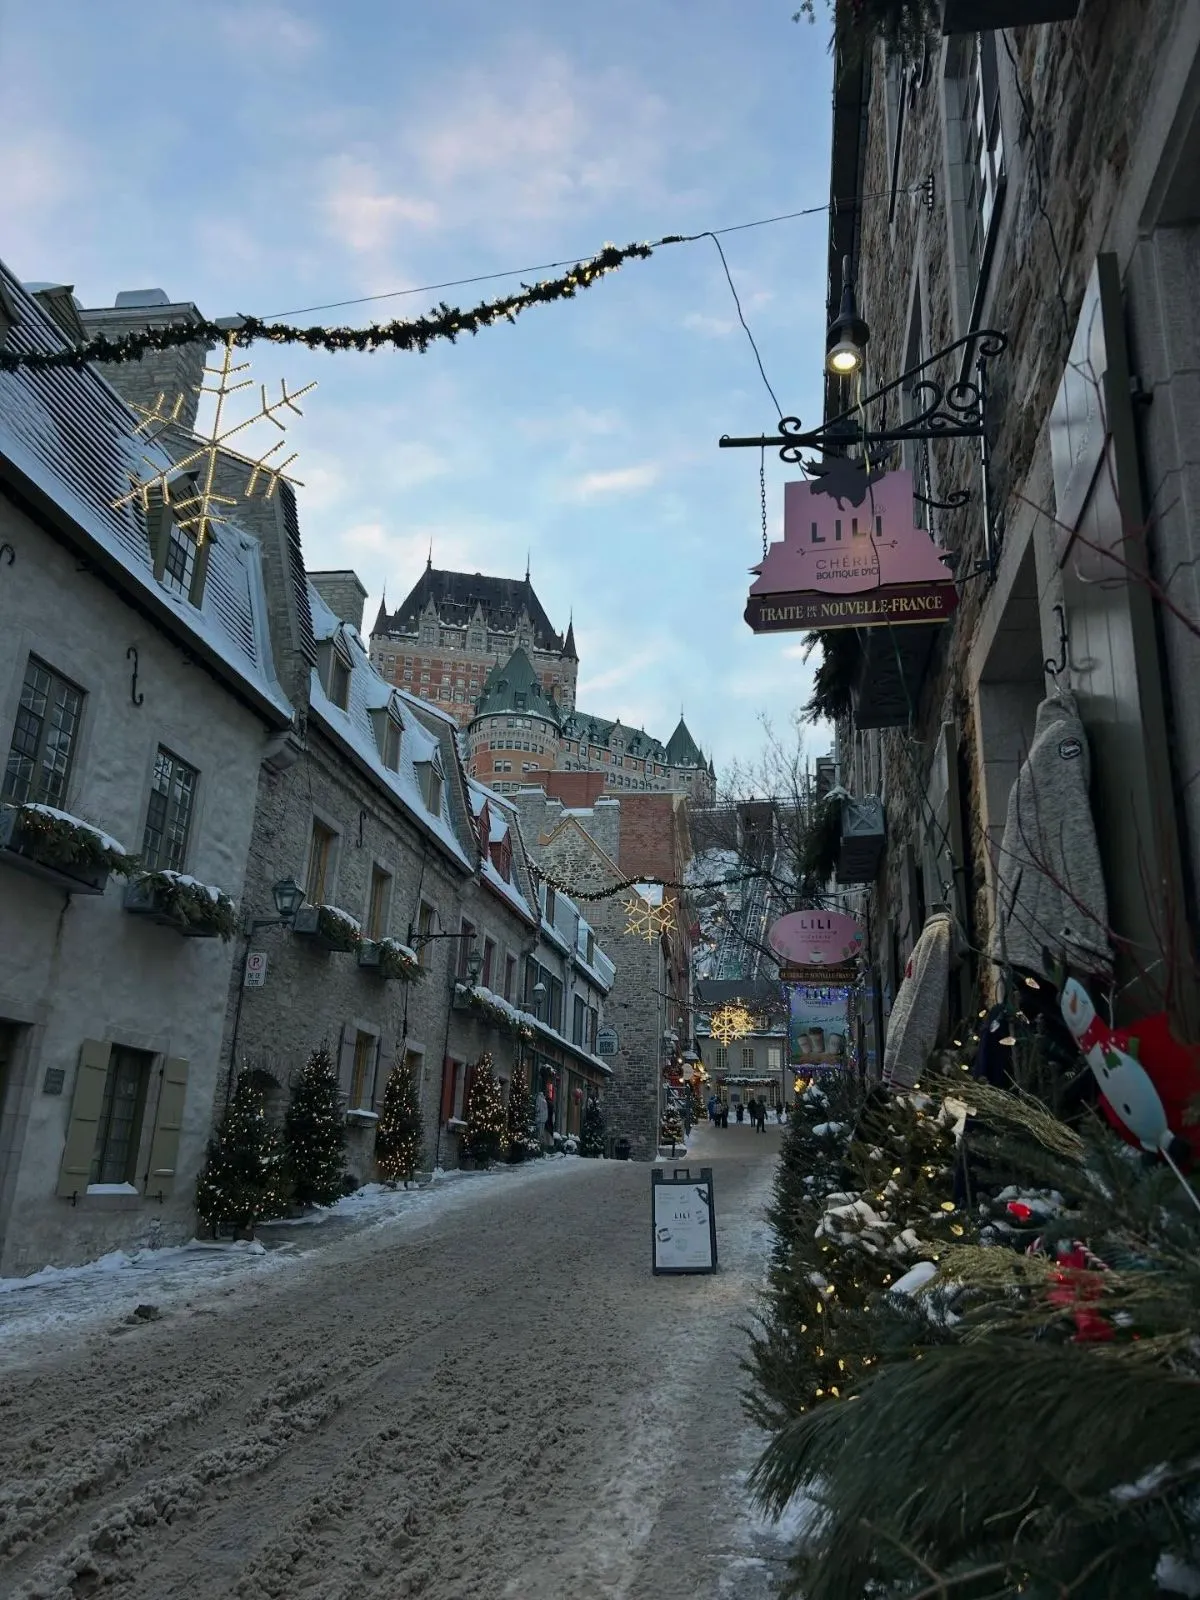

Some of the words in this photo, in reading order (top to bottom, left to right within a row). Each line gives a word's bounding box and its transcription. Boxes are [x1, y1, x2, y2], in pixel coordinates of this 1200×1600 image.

[811, 515, 882, 543] LILI
[816, 555, 879, 570] CHÉRIE
[816, 569, 859, 580] BOUTIQUE
[760, 605, 804, 622] TRAITE
[820, 596, 943, 617] NOUVELLE-FRANCE
[801, 919, 831, 929] LILI
